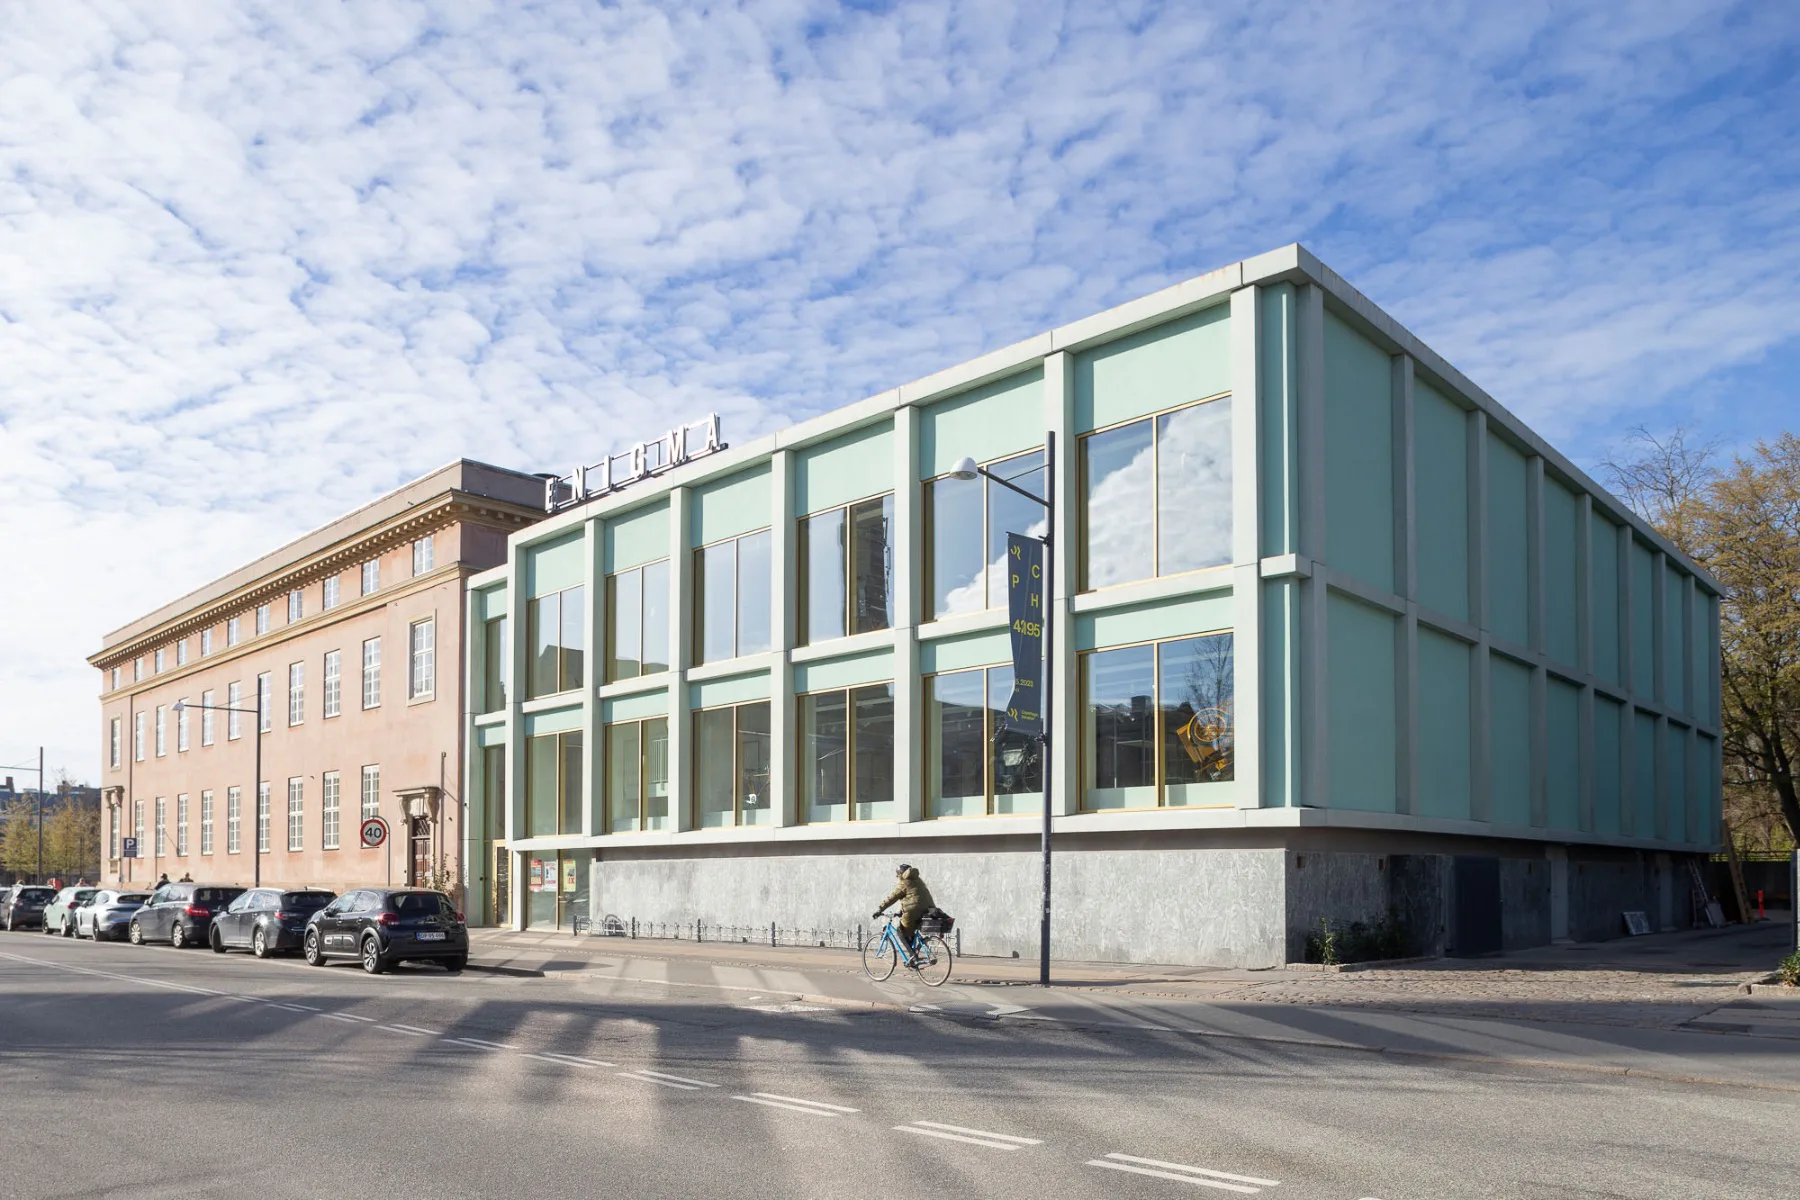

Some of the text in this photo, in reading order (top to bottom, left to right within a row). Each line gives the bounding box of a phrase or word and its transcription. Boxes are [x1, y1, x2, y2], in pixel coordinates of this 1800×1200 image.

[545, 412, 721, 514] ENIGMA
[365, 827, 382, 838] 40
[126, 839, 135, 849] P
